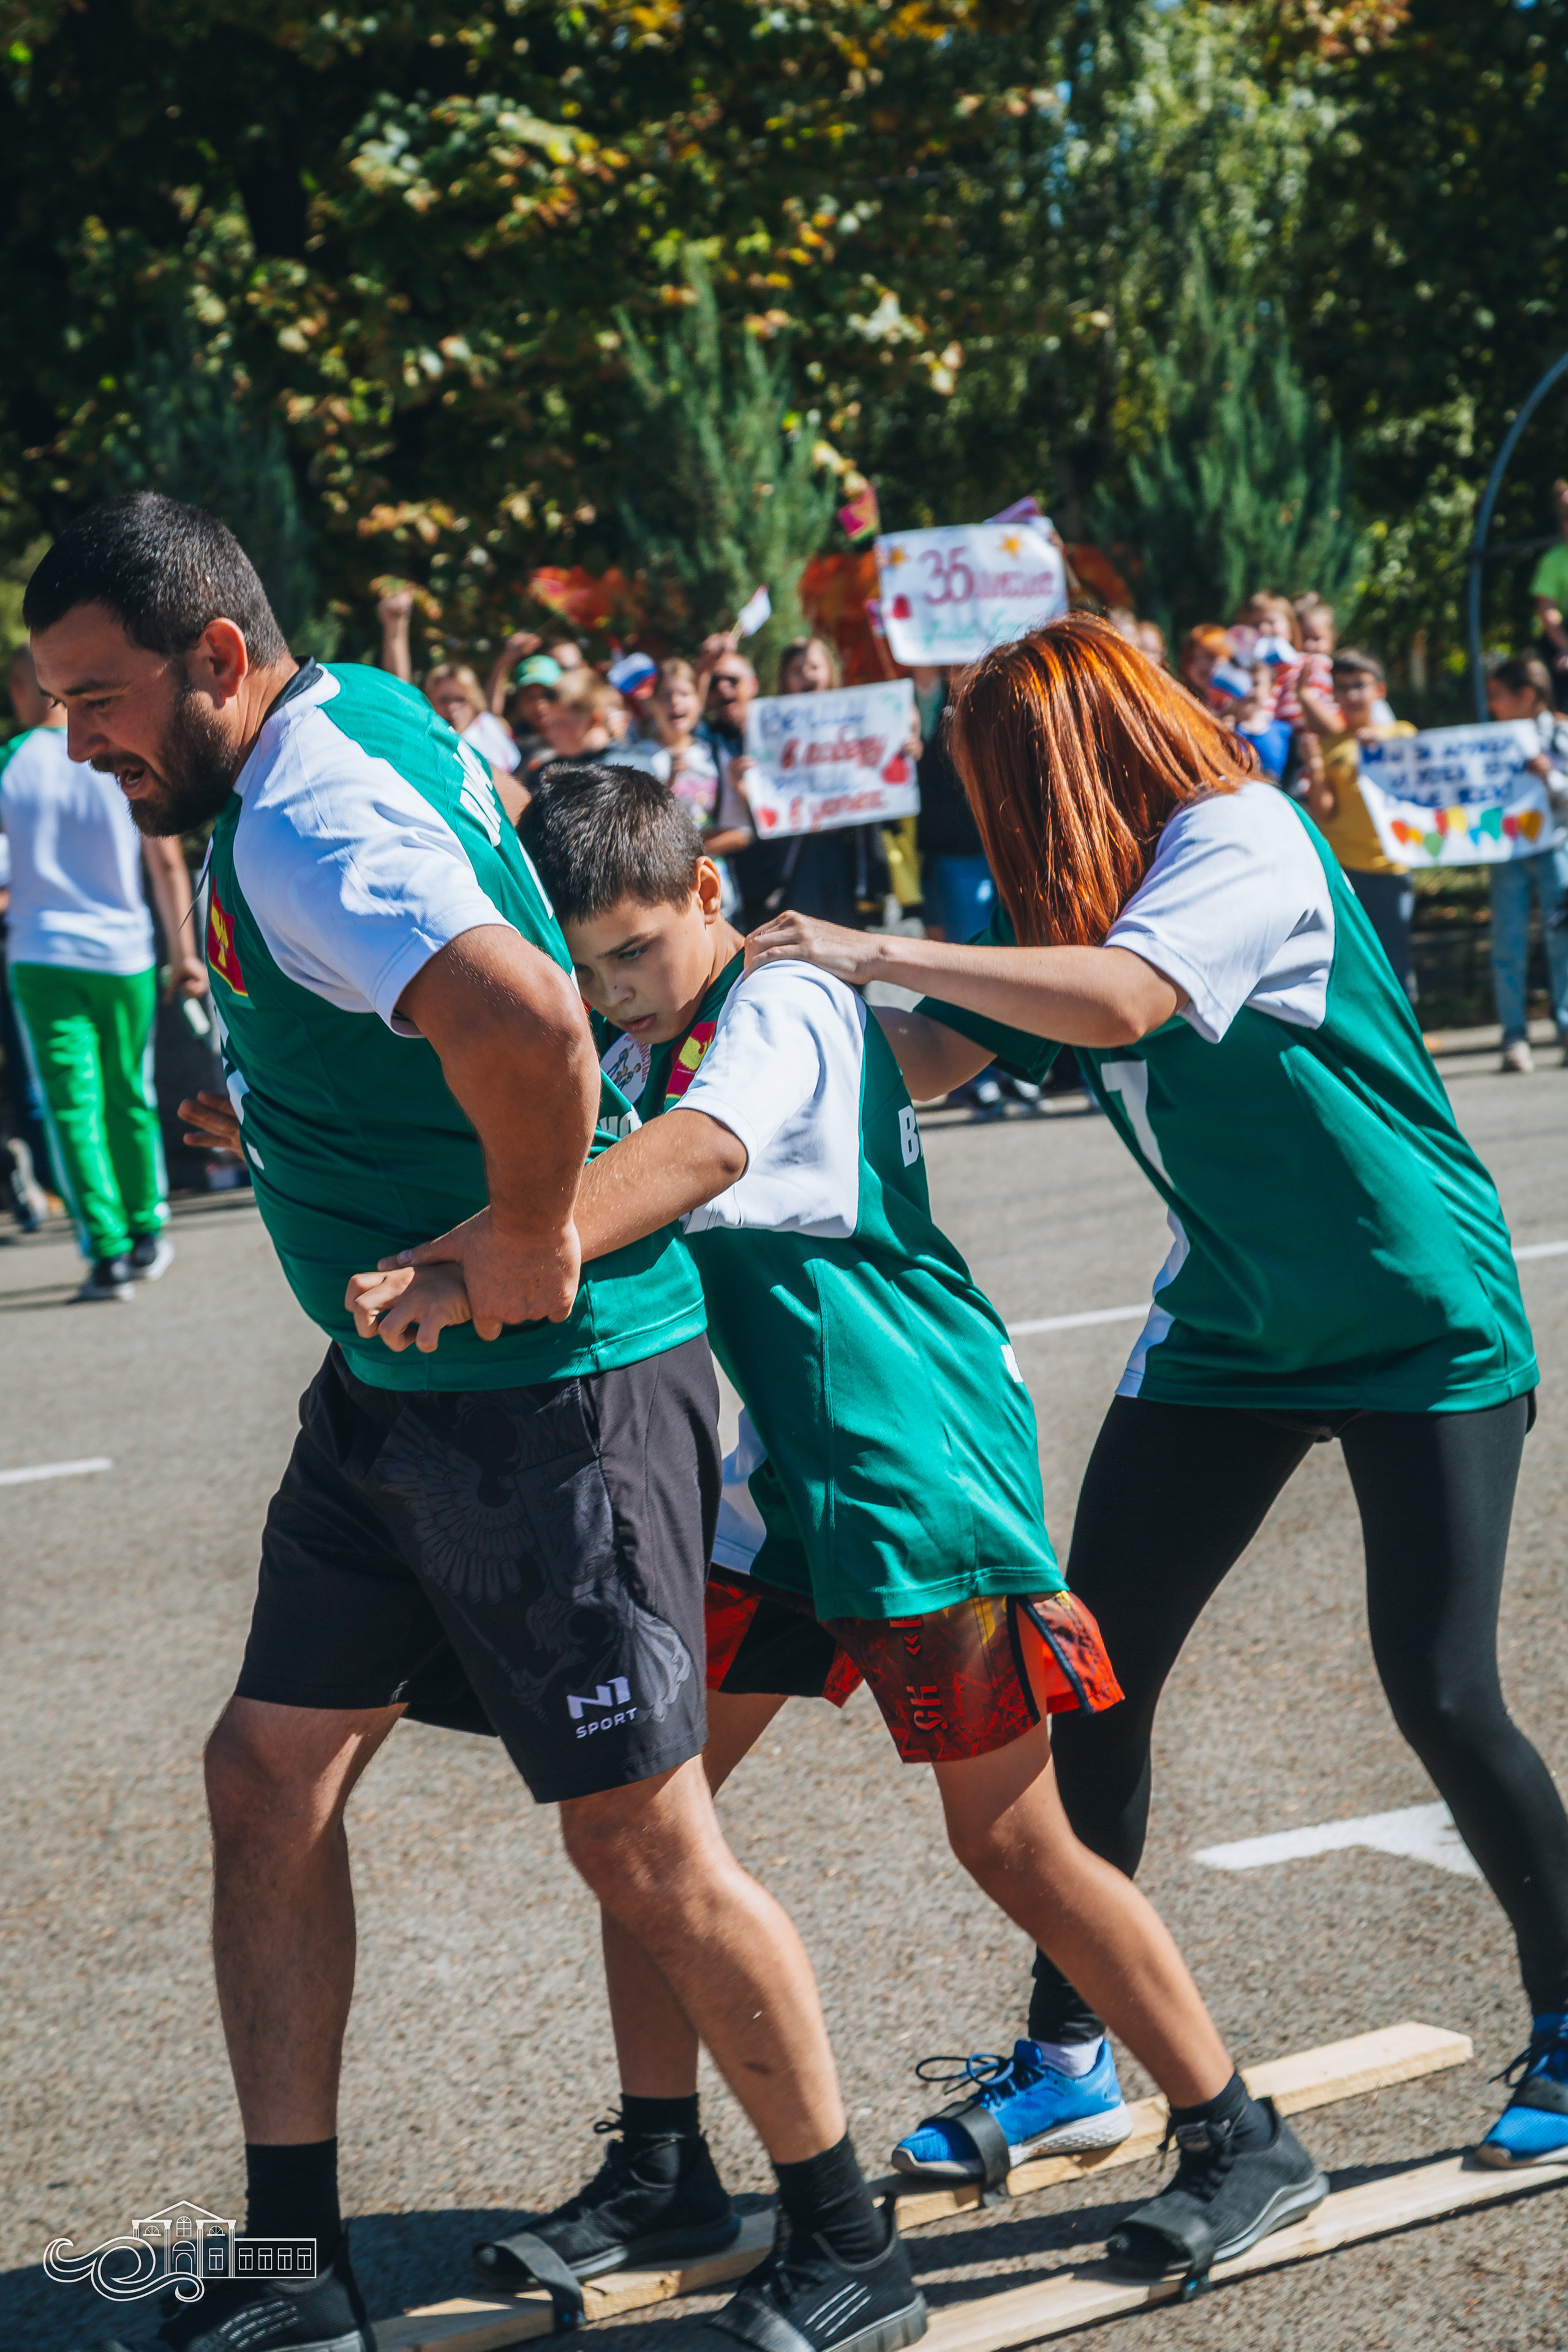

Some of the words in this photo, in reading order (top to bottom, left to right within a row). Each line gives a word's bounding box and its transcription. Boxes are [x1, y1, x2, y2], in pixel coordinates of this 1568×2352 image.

[918, 546, 974, 606] 35
[567, 1676, 631, 1720] N1
[576, 1707, 638, 1739] SPORT
